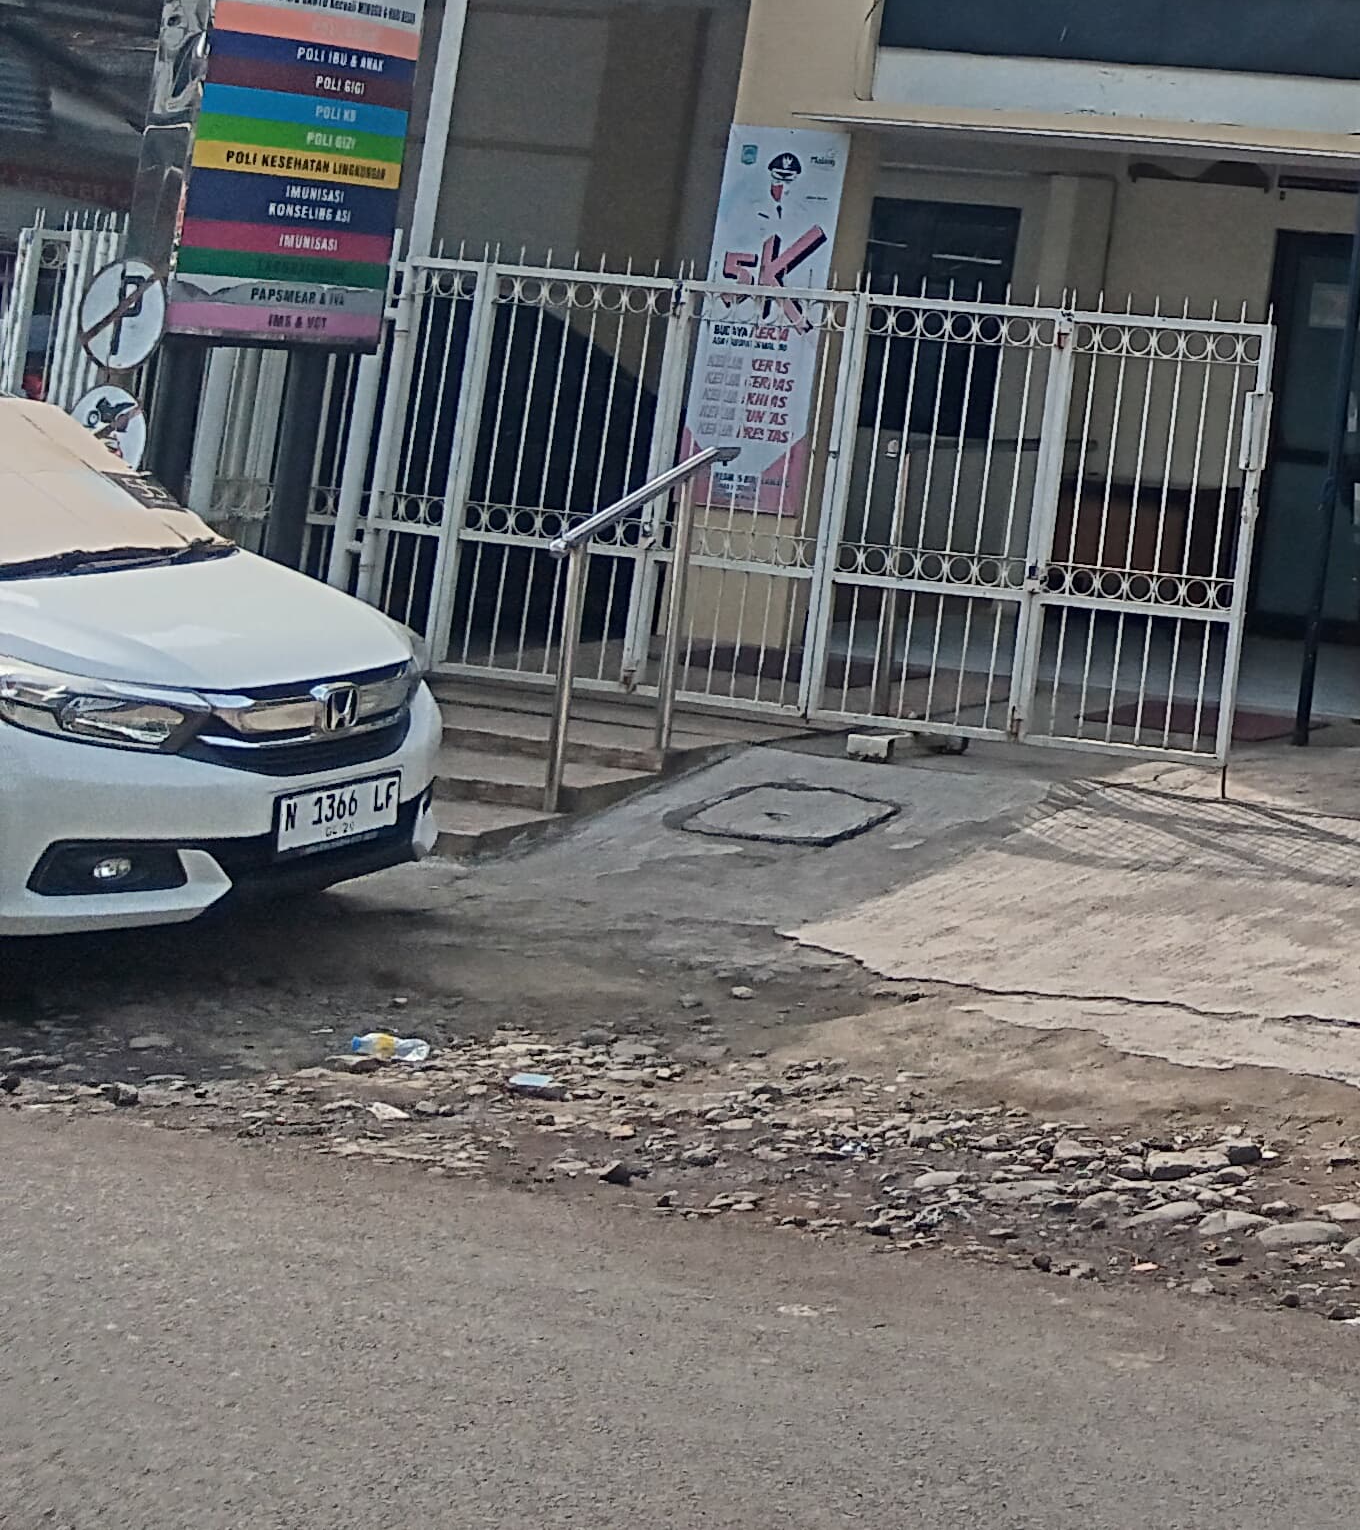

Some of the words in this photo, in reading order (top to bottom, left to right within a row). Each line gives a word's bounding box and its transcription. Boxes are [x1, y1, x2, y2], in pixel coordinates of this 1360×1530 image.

[296, 46, 325, 63] POLI
[328, 50, 348, 67] IBU
[350, 55, 358, 68] &
[360, 56, 384, 72] ANAK
[315, 75, 341, 92] POLI
[344, 79, 365, 95] GIGI
[315, 106, 341, 121] POLI
[306, 131, 332, 147] POLI
[226, 150, 257, 165] POLI
[261, 154, 330, 174] KESEHATAN
[286, 185, 345, 203] IMUNISASI
[268, 203, 333, 221] KONSELING
[335, 209, 351, 223] ASI
[279, 233, 338, 251] IMUNISASI
[250, 287, 316, 304] PAPSMEAR
[319, 293, 327, 305] &
[285, 802, 297, 832] N
[312, 790, 358, 825] 1366
[374, 781, 397, 812] LF
